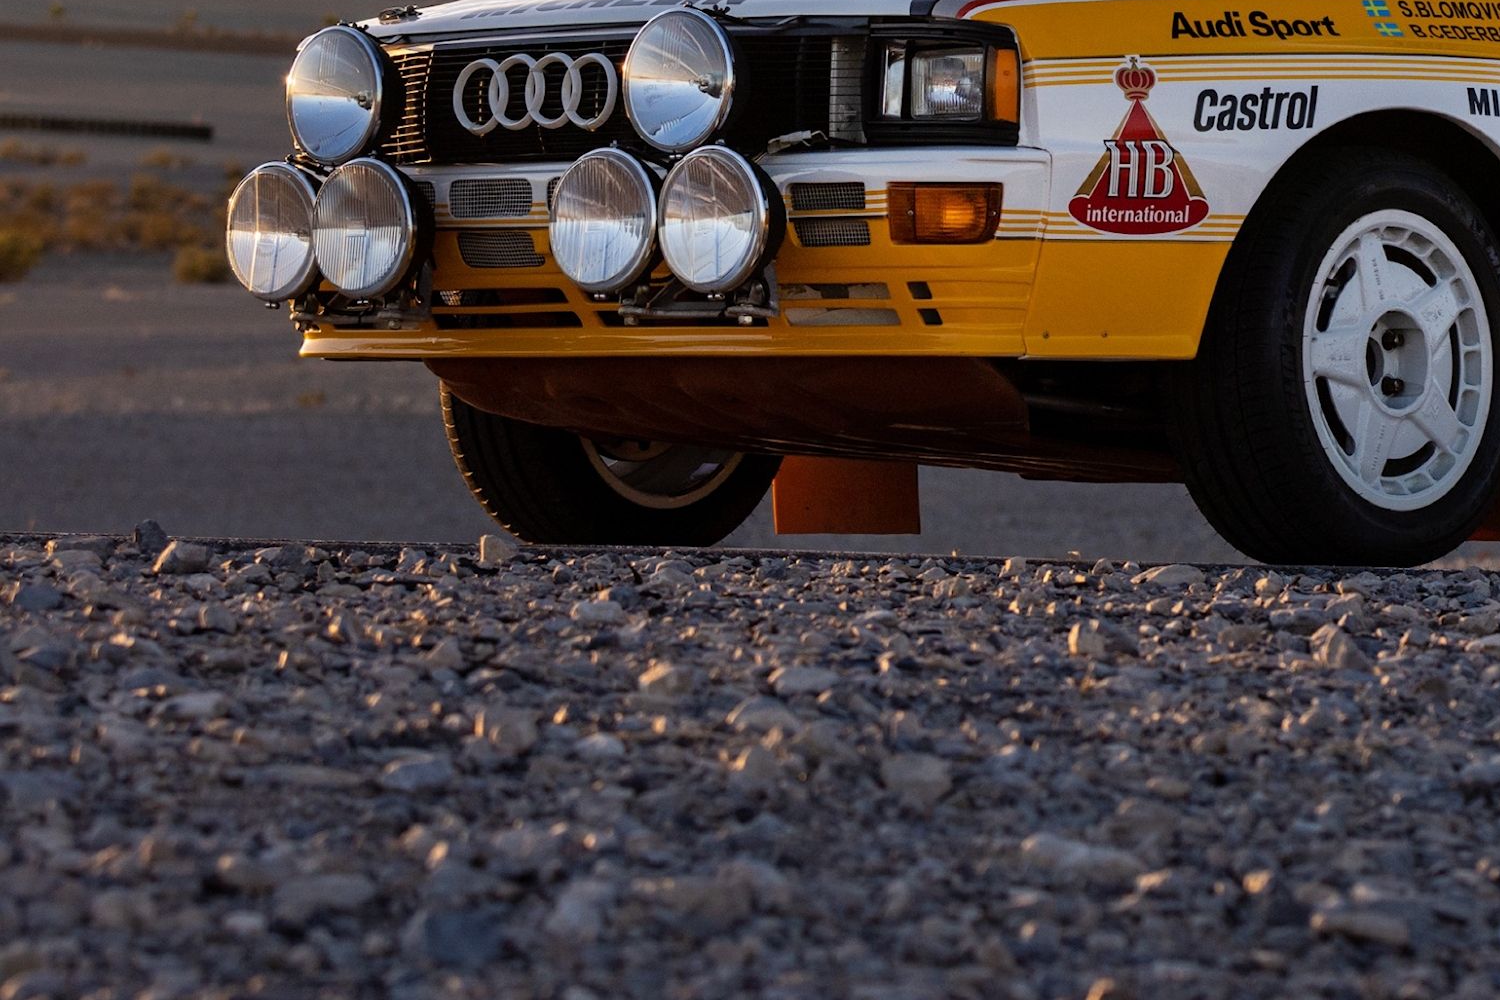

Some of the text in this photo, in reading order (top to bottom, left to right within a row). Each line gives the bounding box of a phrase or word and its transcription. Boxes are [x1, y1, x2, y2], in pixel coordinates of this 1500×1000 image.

[1172, 11, 1340, 40] Audi Sport
[1193, 85, 1319, 132] Castrol
[1104, 139, 1176, 199] HB
[1086, 203, 1190, 223] international
